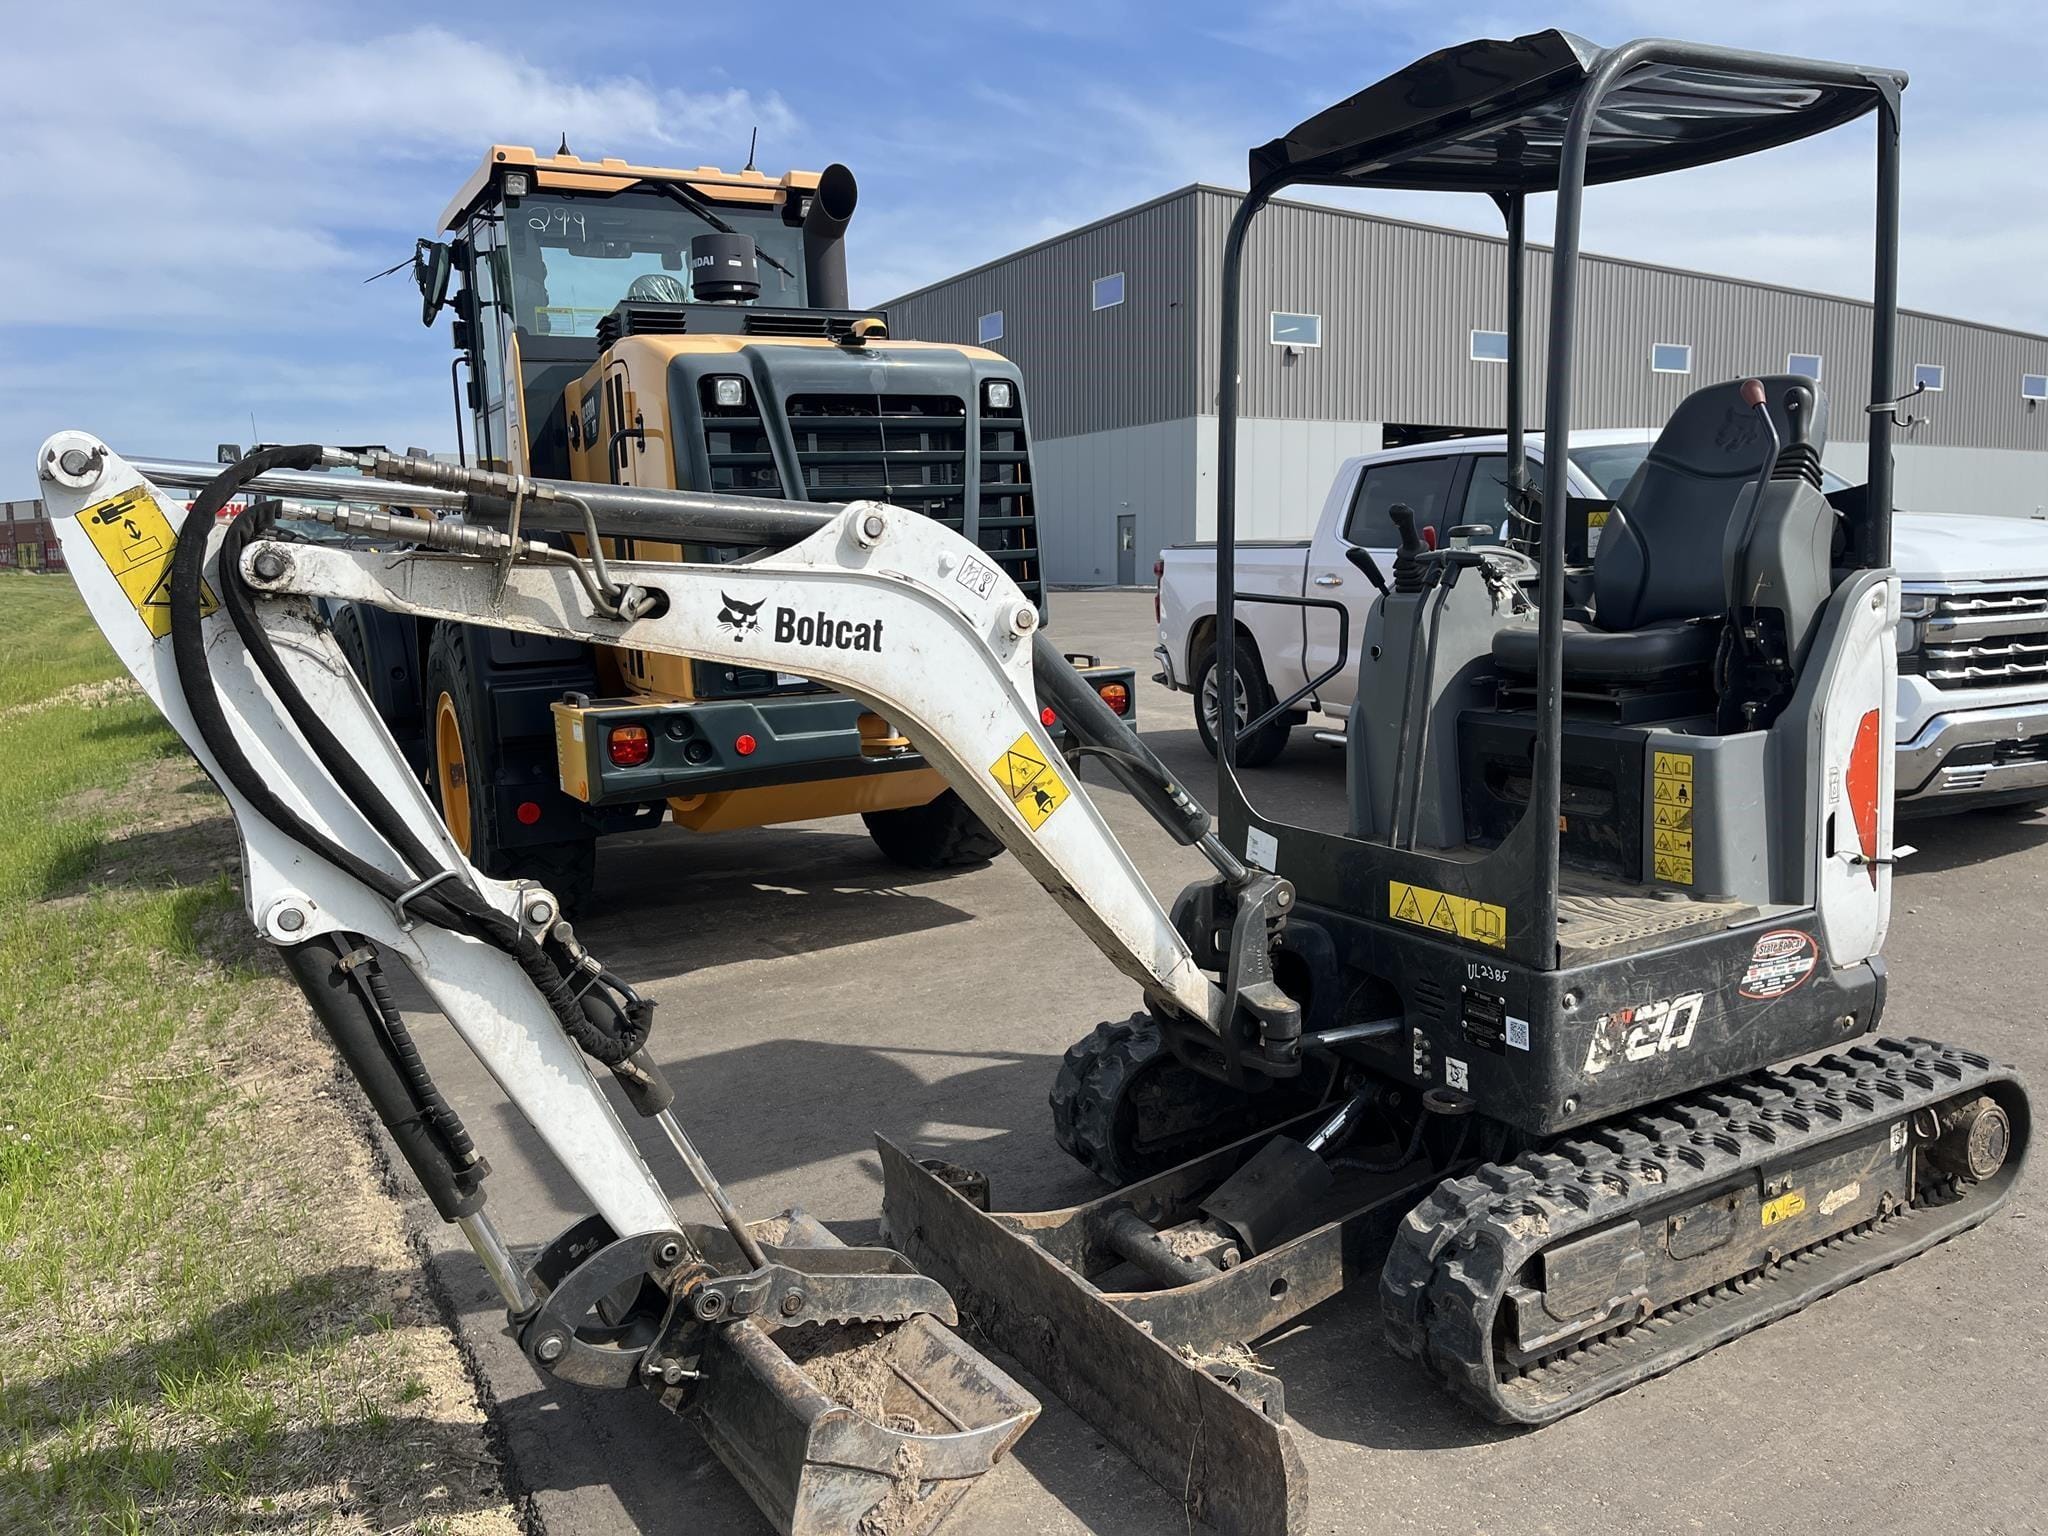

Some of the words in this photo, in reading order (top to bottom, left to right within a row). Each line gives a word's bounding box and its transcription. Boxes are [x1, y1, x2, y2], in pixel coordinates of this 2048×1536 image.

[528, 206, 586, 243] 299
[774, 606, 884, 652] Bobcat
[1467, 963, 1510, 983] UL2385
